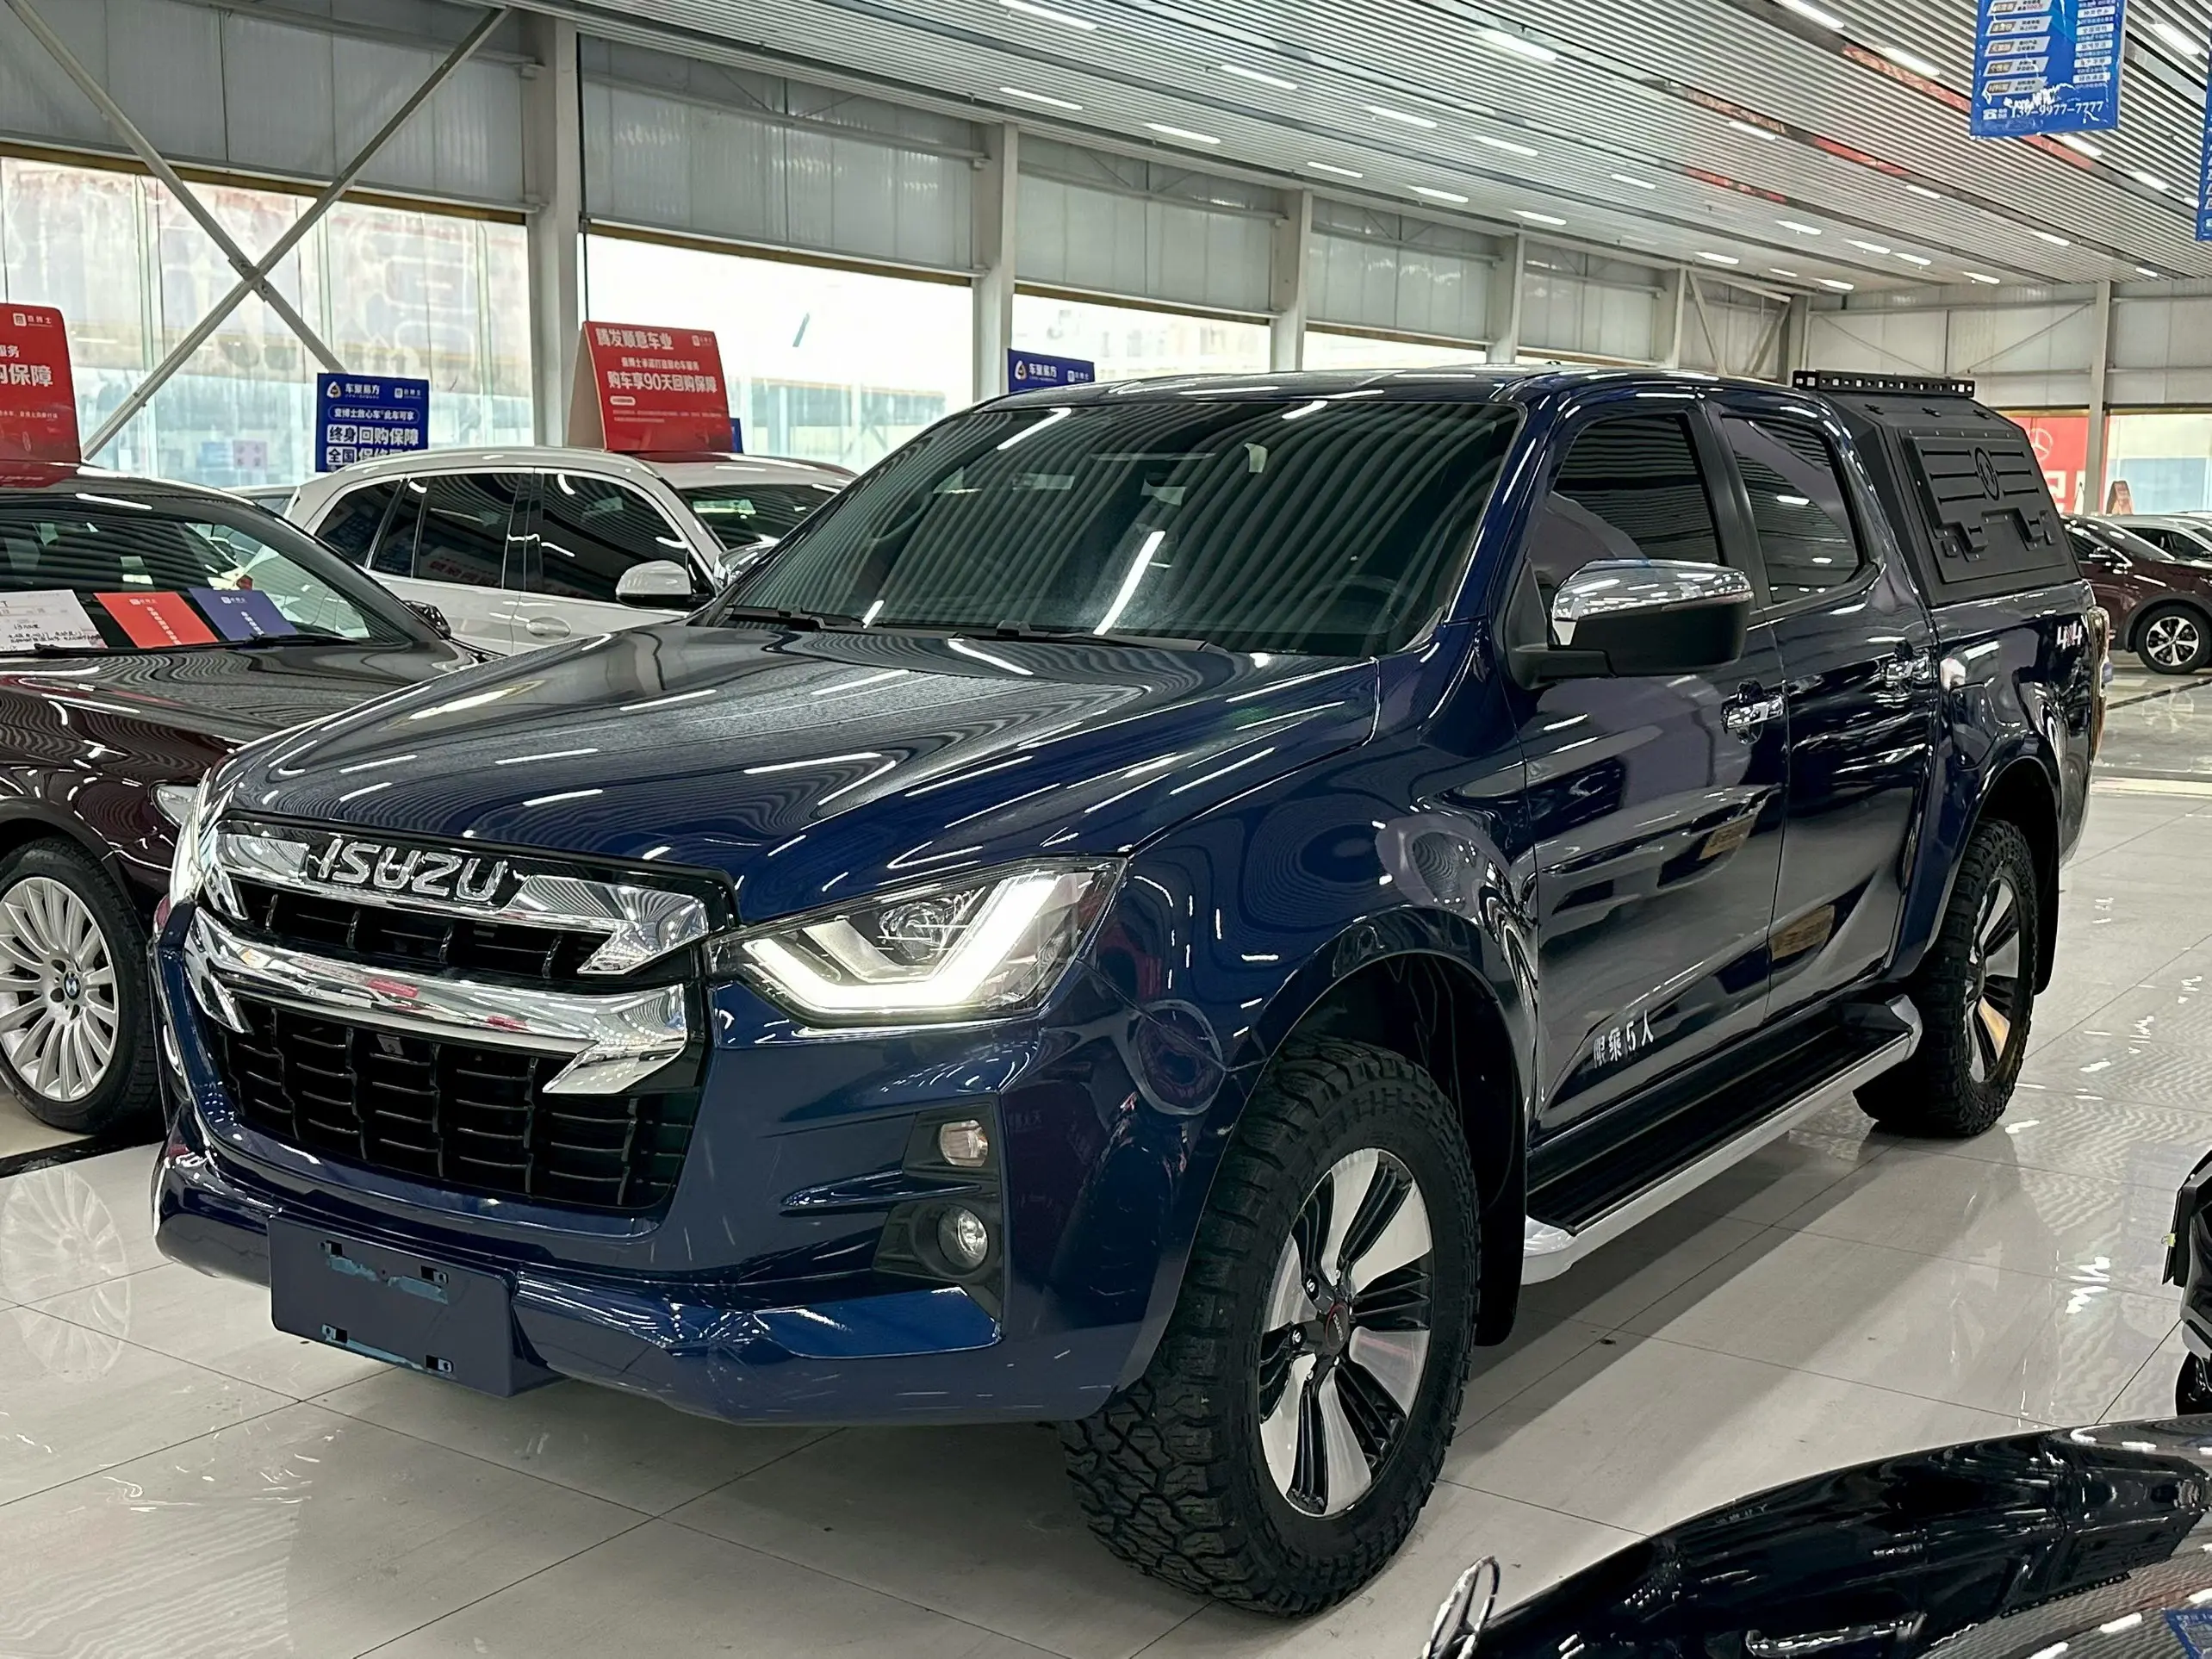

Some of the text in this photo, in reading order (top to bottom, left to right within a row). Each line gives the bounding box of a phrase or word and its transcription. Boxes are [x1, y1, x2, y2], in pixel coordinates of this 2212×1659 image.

[606, 371, 718, 393] 购车享90天回购保障
[318, 838, 508, 902] ISUZU
[1593, 1009, 1655, 1069] 限乘5人
